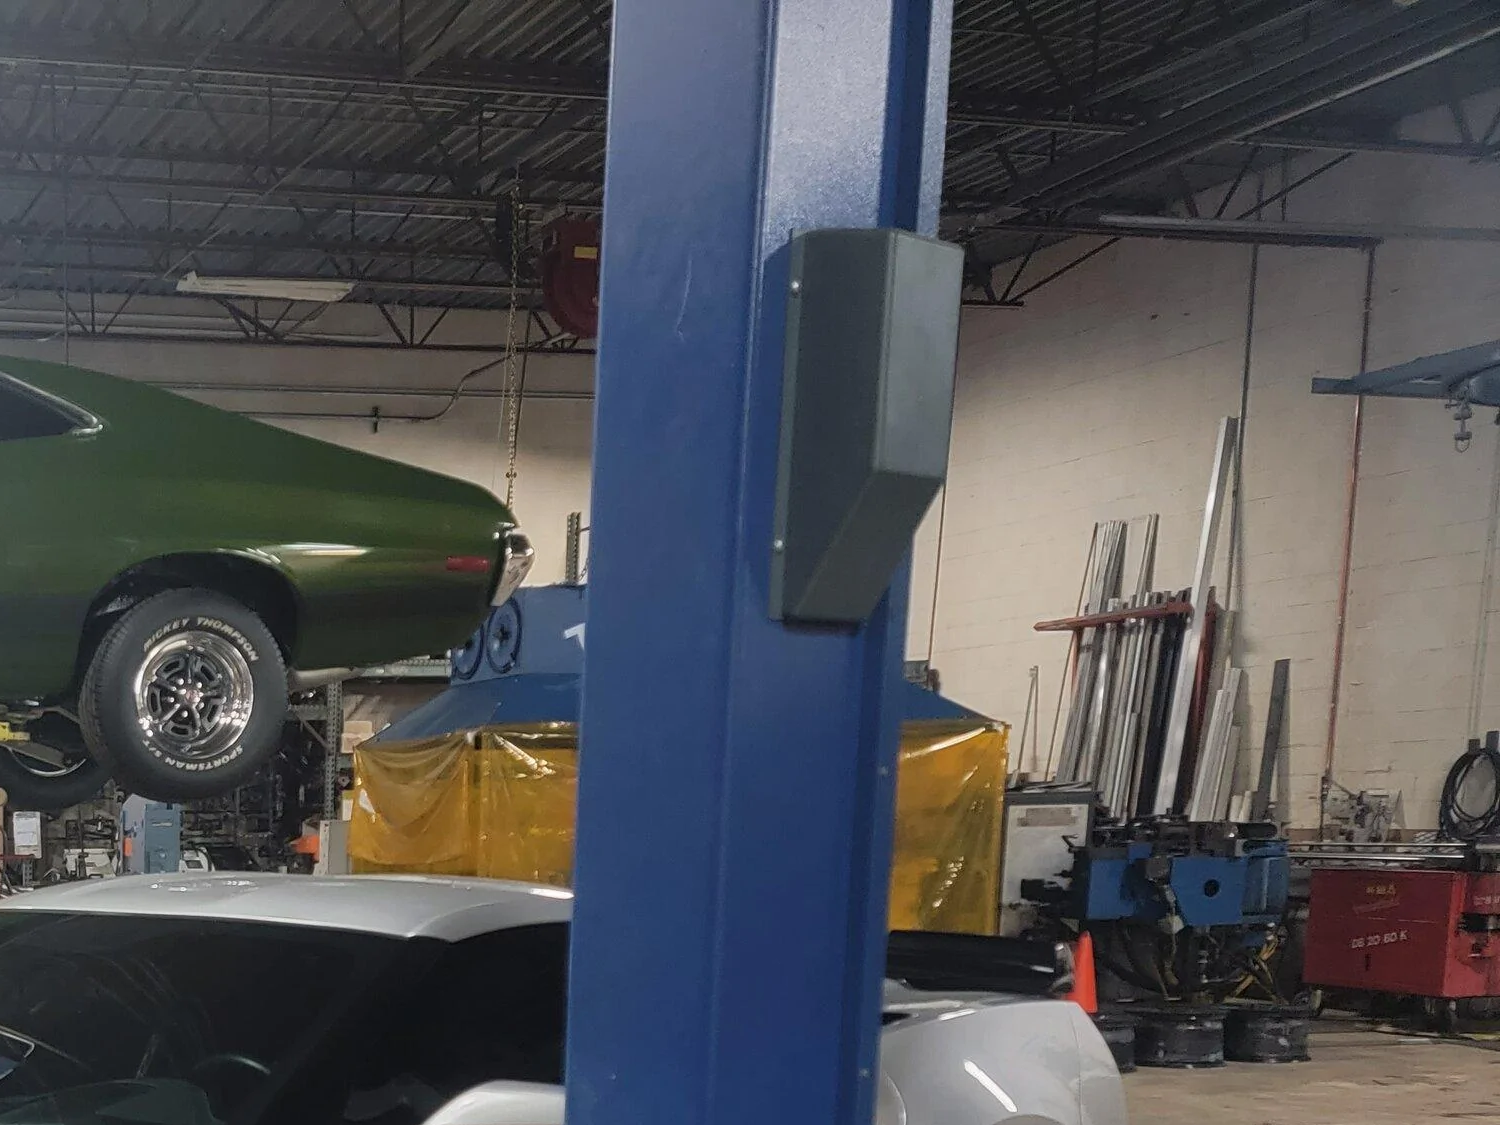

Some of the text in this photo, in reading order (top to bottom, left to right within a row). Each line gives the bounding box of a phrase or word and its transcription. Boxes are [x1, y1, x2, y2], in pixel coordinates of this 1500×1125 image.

[143, 616, 259, 662] MICKEY THOMPSON
[165, 746, 244, 772] SPORTSMAN
